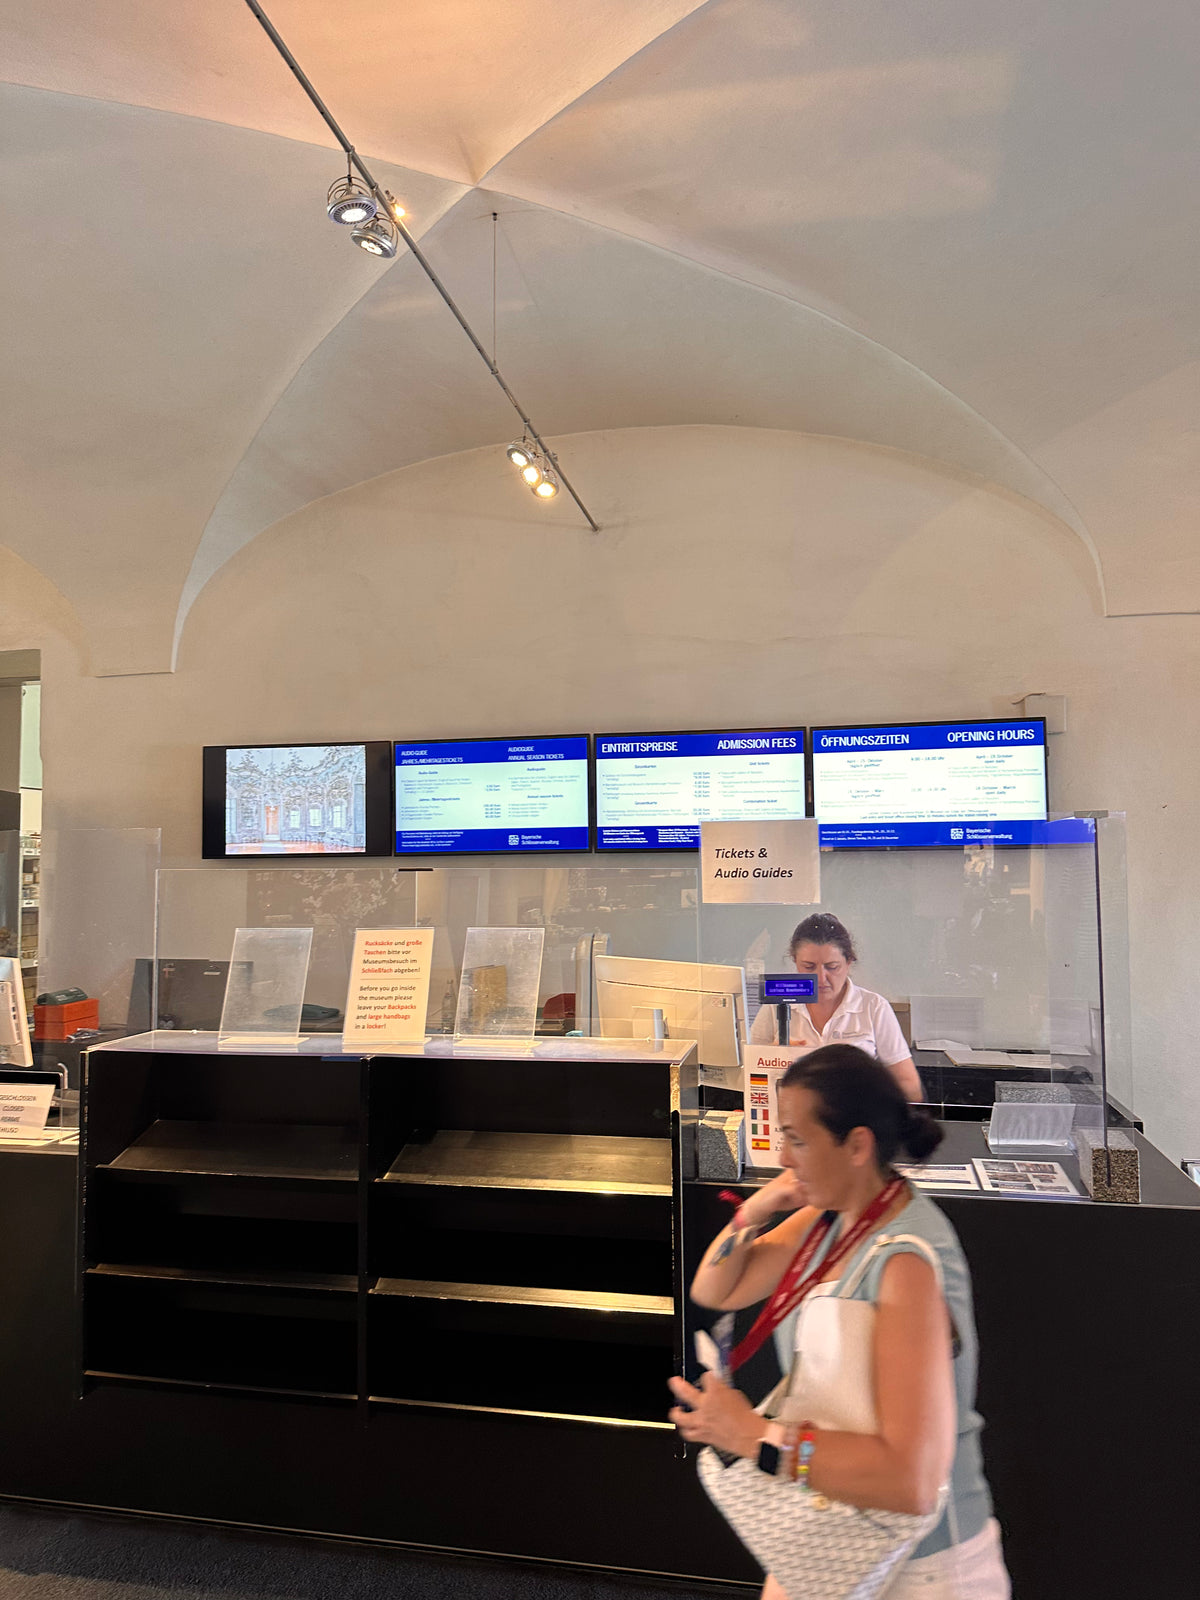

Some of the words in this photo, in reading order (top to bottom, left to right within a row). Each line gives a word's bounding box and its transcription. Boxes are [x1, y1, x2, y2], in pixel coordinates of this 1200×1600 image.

[821, 734, 910, 747] ÖFFNUNGSZEITEN
[947, 731, 995, 743] OPENING
[997, 729, 1035, 741] HOURS
[602, 741, 678, 753] EINTRITTSPREISE
[718, 739, 769, 749] ADMISSION
[772, 738, 796, 748] FEES
[715, 848, 755, 858] Tickets
[758, 848, 768, 858] &
[714, 868, 749, 878] Audio
[752, 868, 793, 878] Guides
